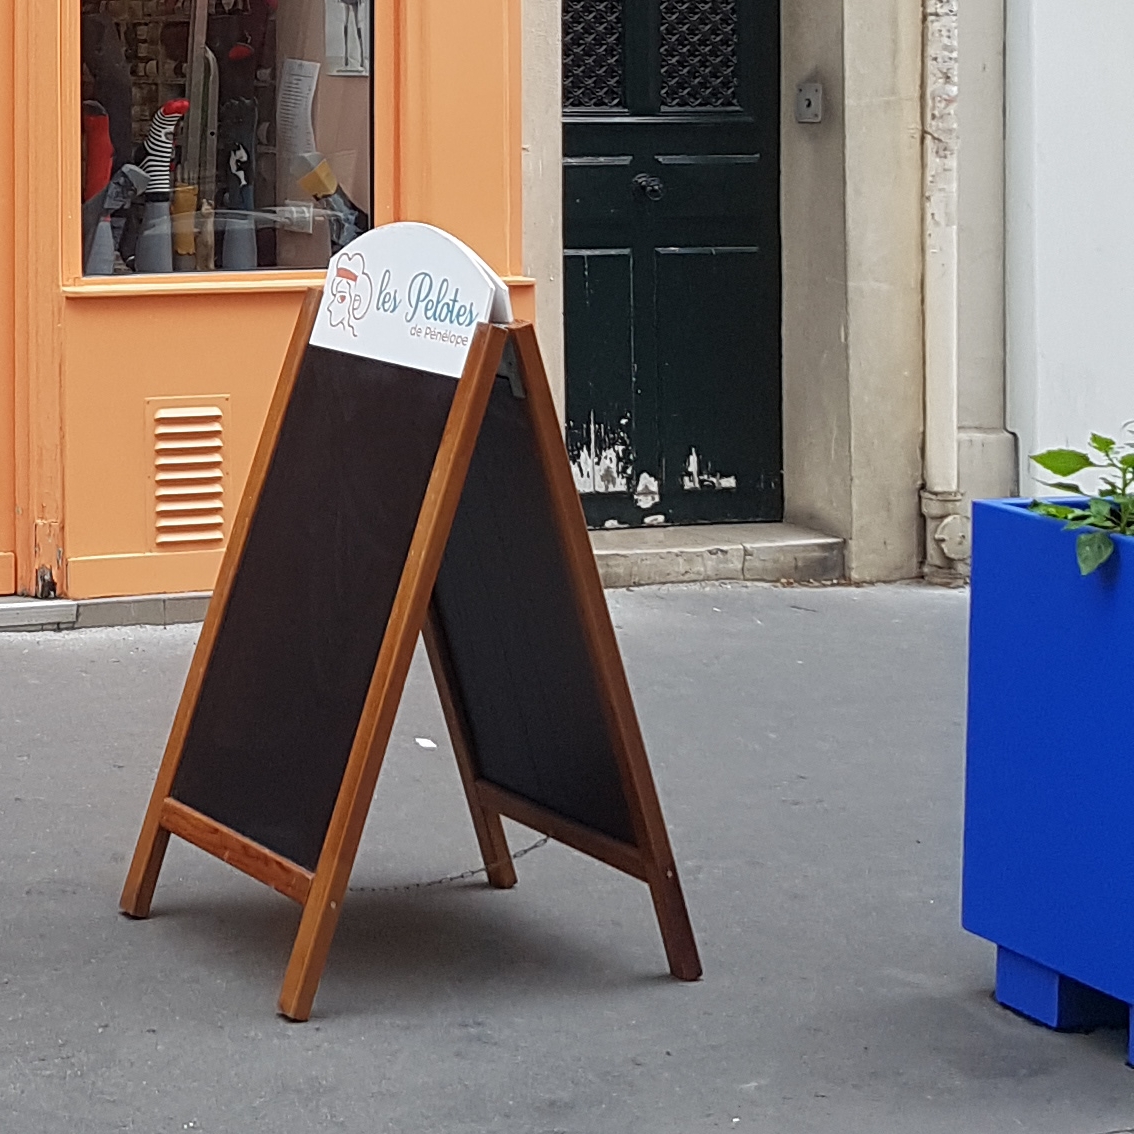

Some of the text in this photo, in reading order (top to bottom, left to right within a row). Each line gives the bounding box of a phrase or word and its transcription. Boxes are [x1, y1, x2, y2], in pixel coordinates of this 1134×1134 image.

[376, 269, 479, 327] les Pelotes
[409, 325, 469, 347] de Pénélope
